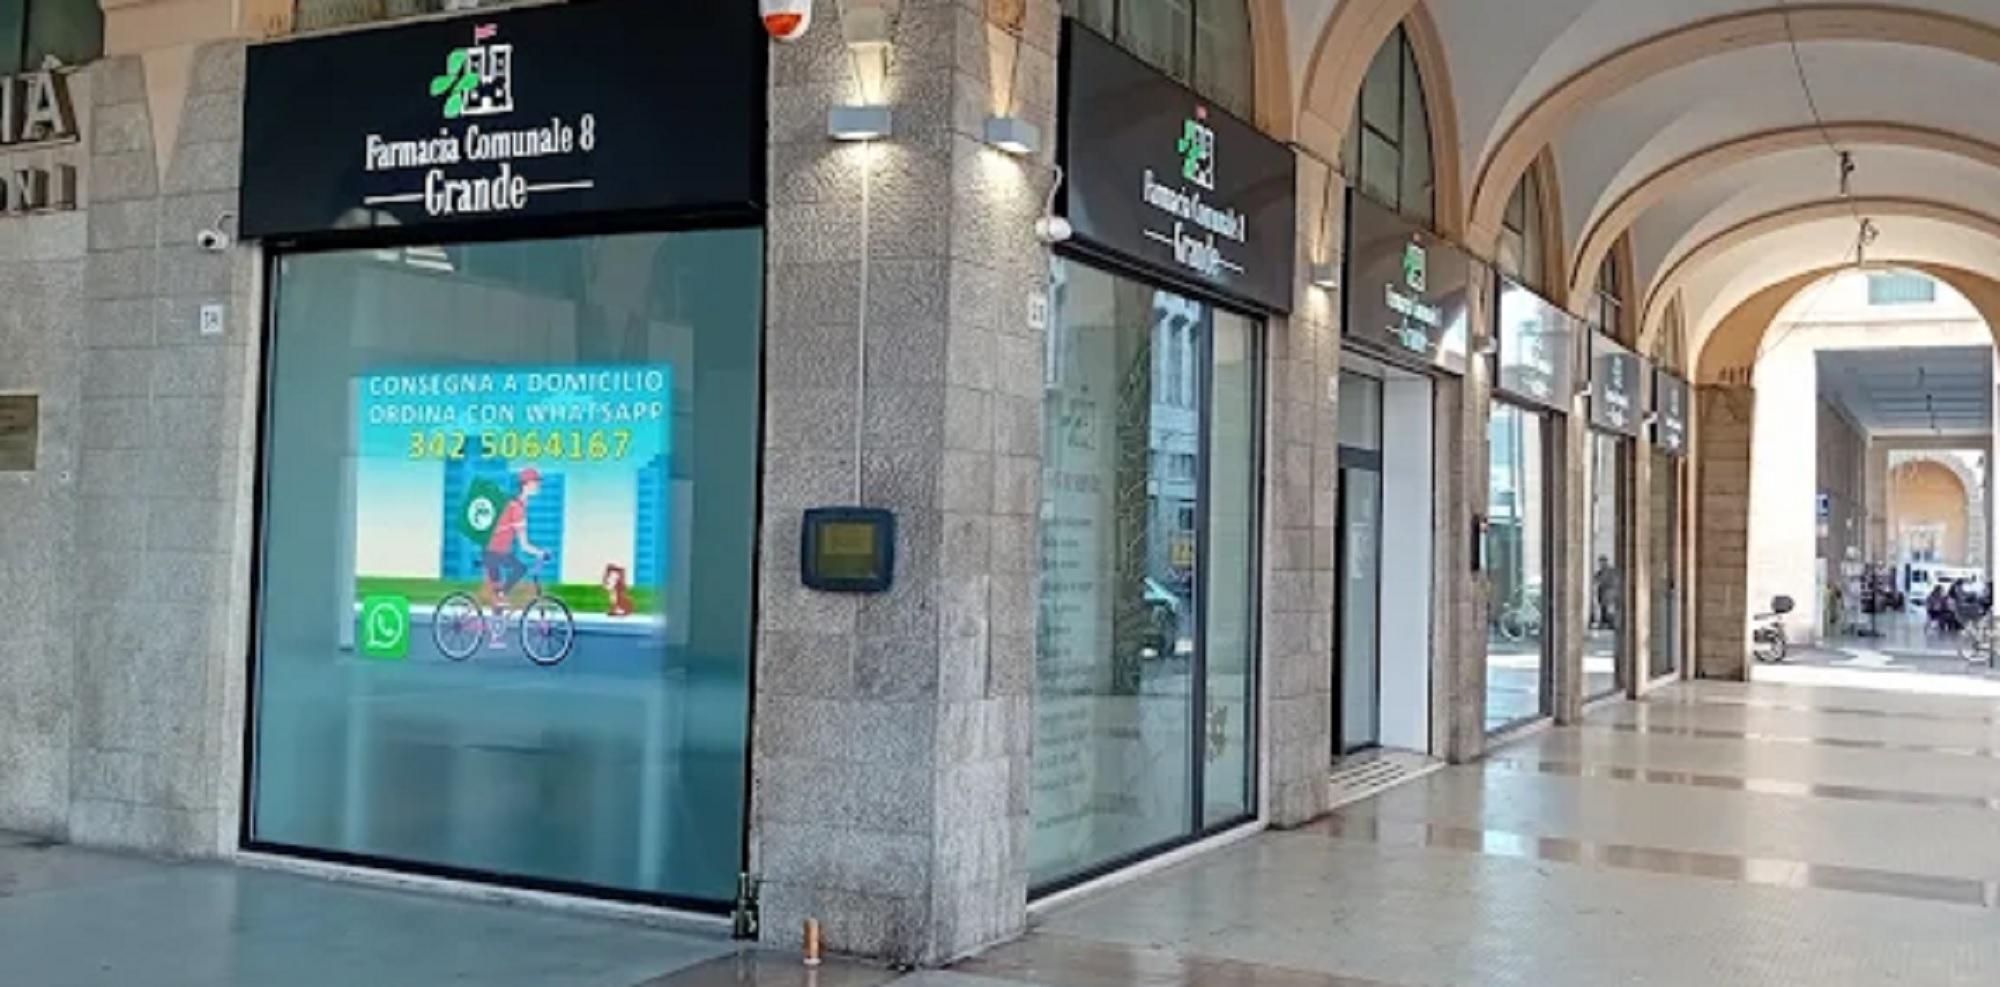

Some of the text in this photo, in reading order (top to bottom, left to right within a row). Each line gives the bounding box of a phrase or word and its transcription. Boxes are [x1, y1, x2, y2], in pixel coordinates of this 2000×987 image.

[365, 113, 595, 171] Farmacia Comunale 8
[424, 163, 527, 216] Grande
[370, 370, 662, 395] CONSEGNA A DOMICILIO
[369, 401, 661, 423] ORDINA CON WHATSAPP
[408, 430, 631, 458] 342 5064167
